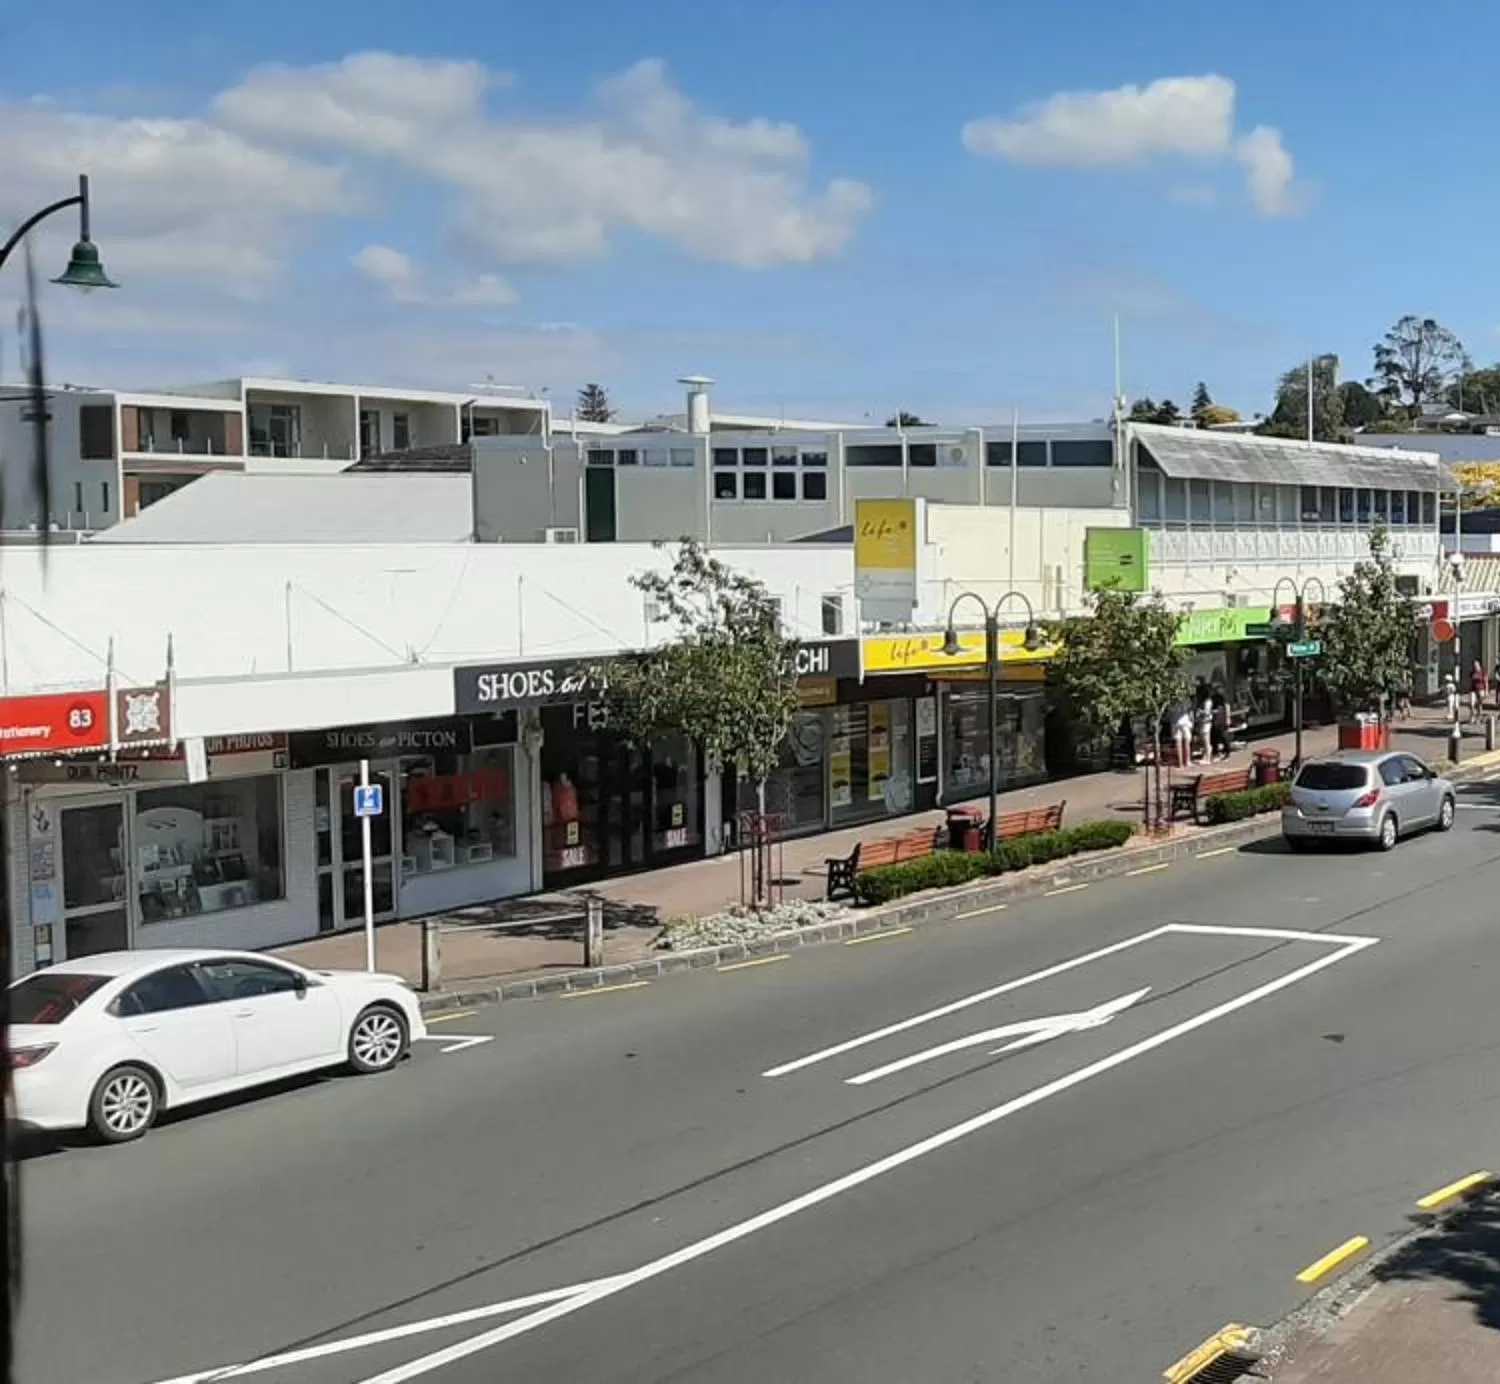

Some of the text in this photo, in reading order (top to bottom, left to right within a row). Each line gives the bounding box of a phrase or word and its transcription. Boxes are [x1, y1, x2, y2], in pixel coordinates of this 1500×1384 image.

[477, 669, 555, 701] SHOES
[69, 708, 92, 728] 83
[325, 730, 374, 748] SHOES
[399, 730, 457, 748] PICTON
[666, 827, 689, 848] SALE
[561, 846, 587, 868] SALE
